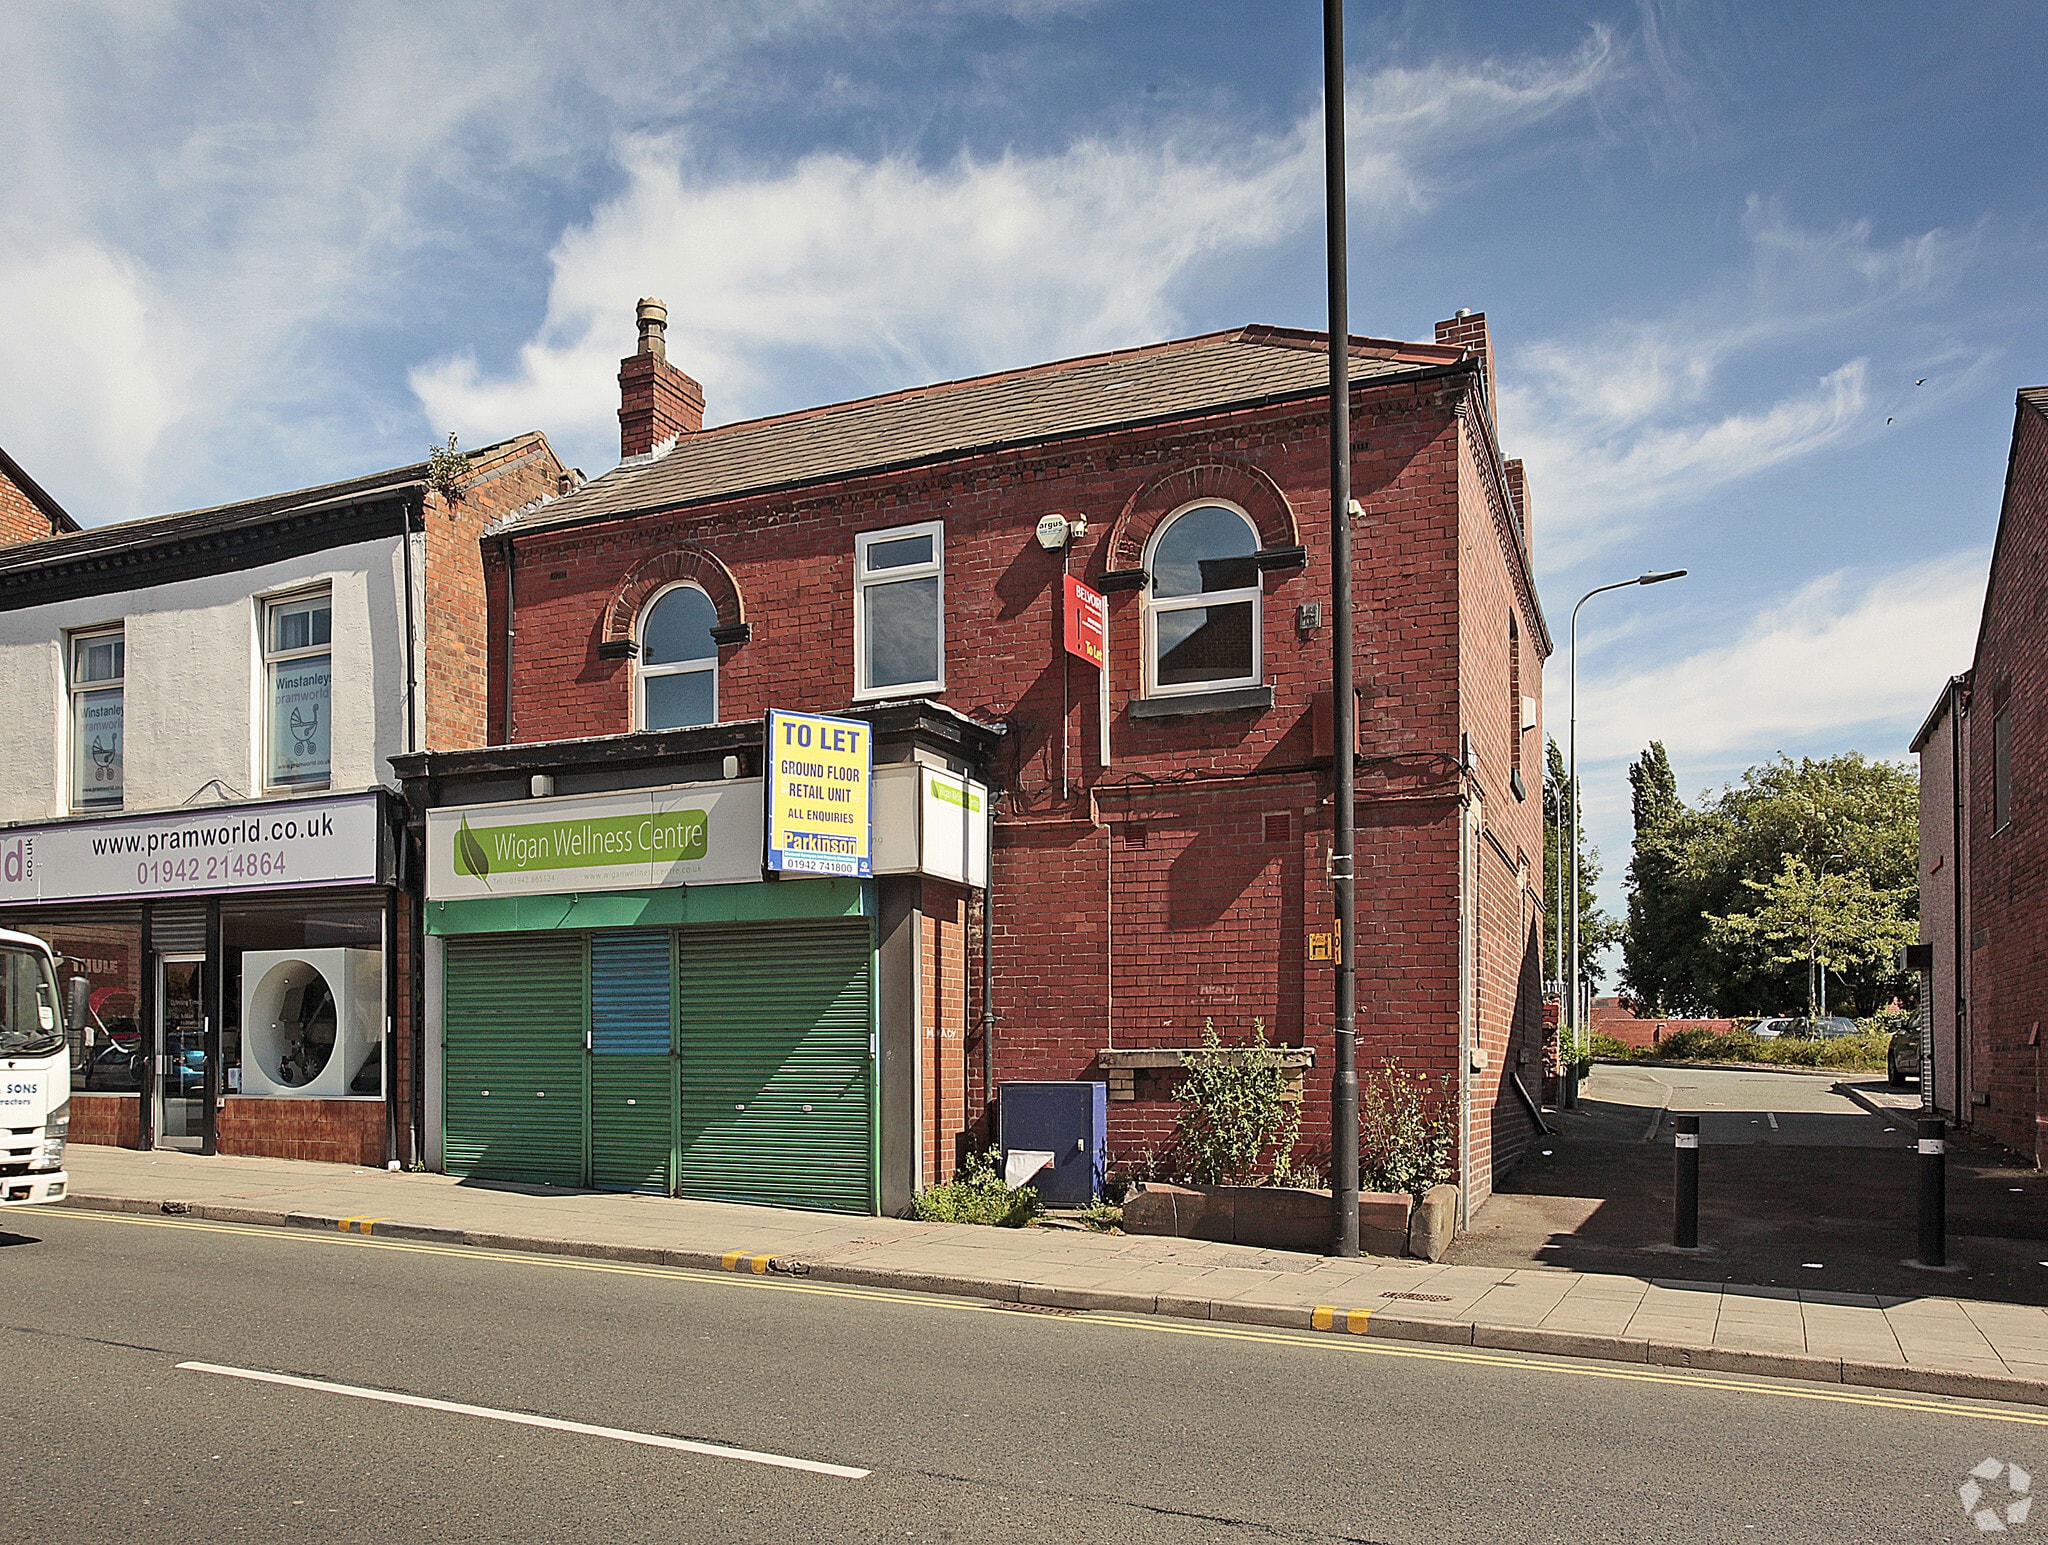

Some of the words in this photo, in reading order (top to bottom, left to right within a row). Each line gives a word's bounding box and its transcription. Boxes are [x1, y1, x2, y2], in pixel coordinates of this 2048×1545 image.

[1039, 520, 1063, 529] argus
[1085, 640, 1093, 656] To
[1094, 645, 1102, 661] Let
[275, 687, 329, 707] pramworld
[782, 722, 812, 748] TO
[820, 727, 860, 754] LET
[781, 760, 824, 779] GROUND
[827, 765, 860, 783] FLOOR
[788, 783, 825, 801] RETAIL
[828, 788, 851, 803] UNIT
[788, 808, 804, 820] ALL
[806, 810, 854, 824] ENQUIRIES
[92, 812, 334, 857] www.pramworld.co.uk
[494, 833, 549, 867] Wigan
[553, 825, 633, 857] Wellness
[638, 820, 703, 850] Centre
[783, 831, 857, 855] Parkinson
[25, 838, 33, 881] .co.uk
[137, 857, 200, 885] 01942
[206, 850, 286, 880] 214864
[787, 859, 816, 870] 01942
[819, 861, 853, 873] 741800
[492, 877, 503, 885] Tel
[509, 876, 529, 884] 01942
[71, 958, 118, 974] THULE
[7, 1084, 38, 1093] SONS
